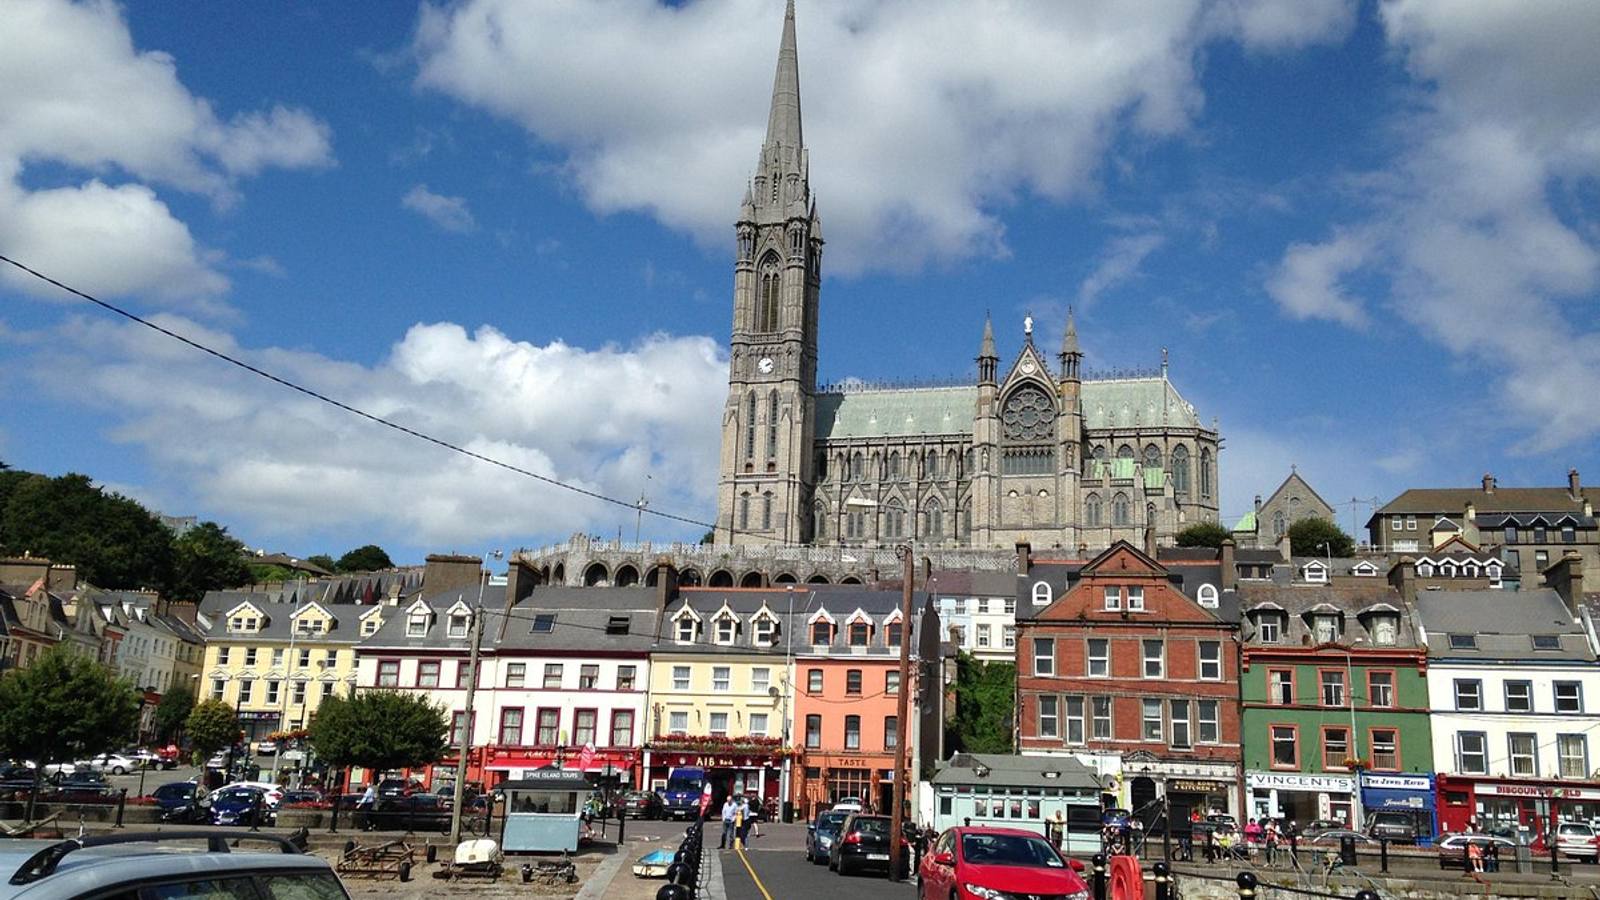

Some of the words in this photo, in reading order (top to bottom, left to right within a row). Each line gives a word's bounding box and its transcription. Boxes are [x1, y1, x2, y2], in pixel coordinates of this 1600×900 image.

[696, 756, 715, 766] AIB
[838, 758, 866, 767] TASTE
[1256, 775, 1348, 788] VINCENT'S
